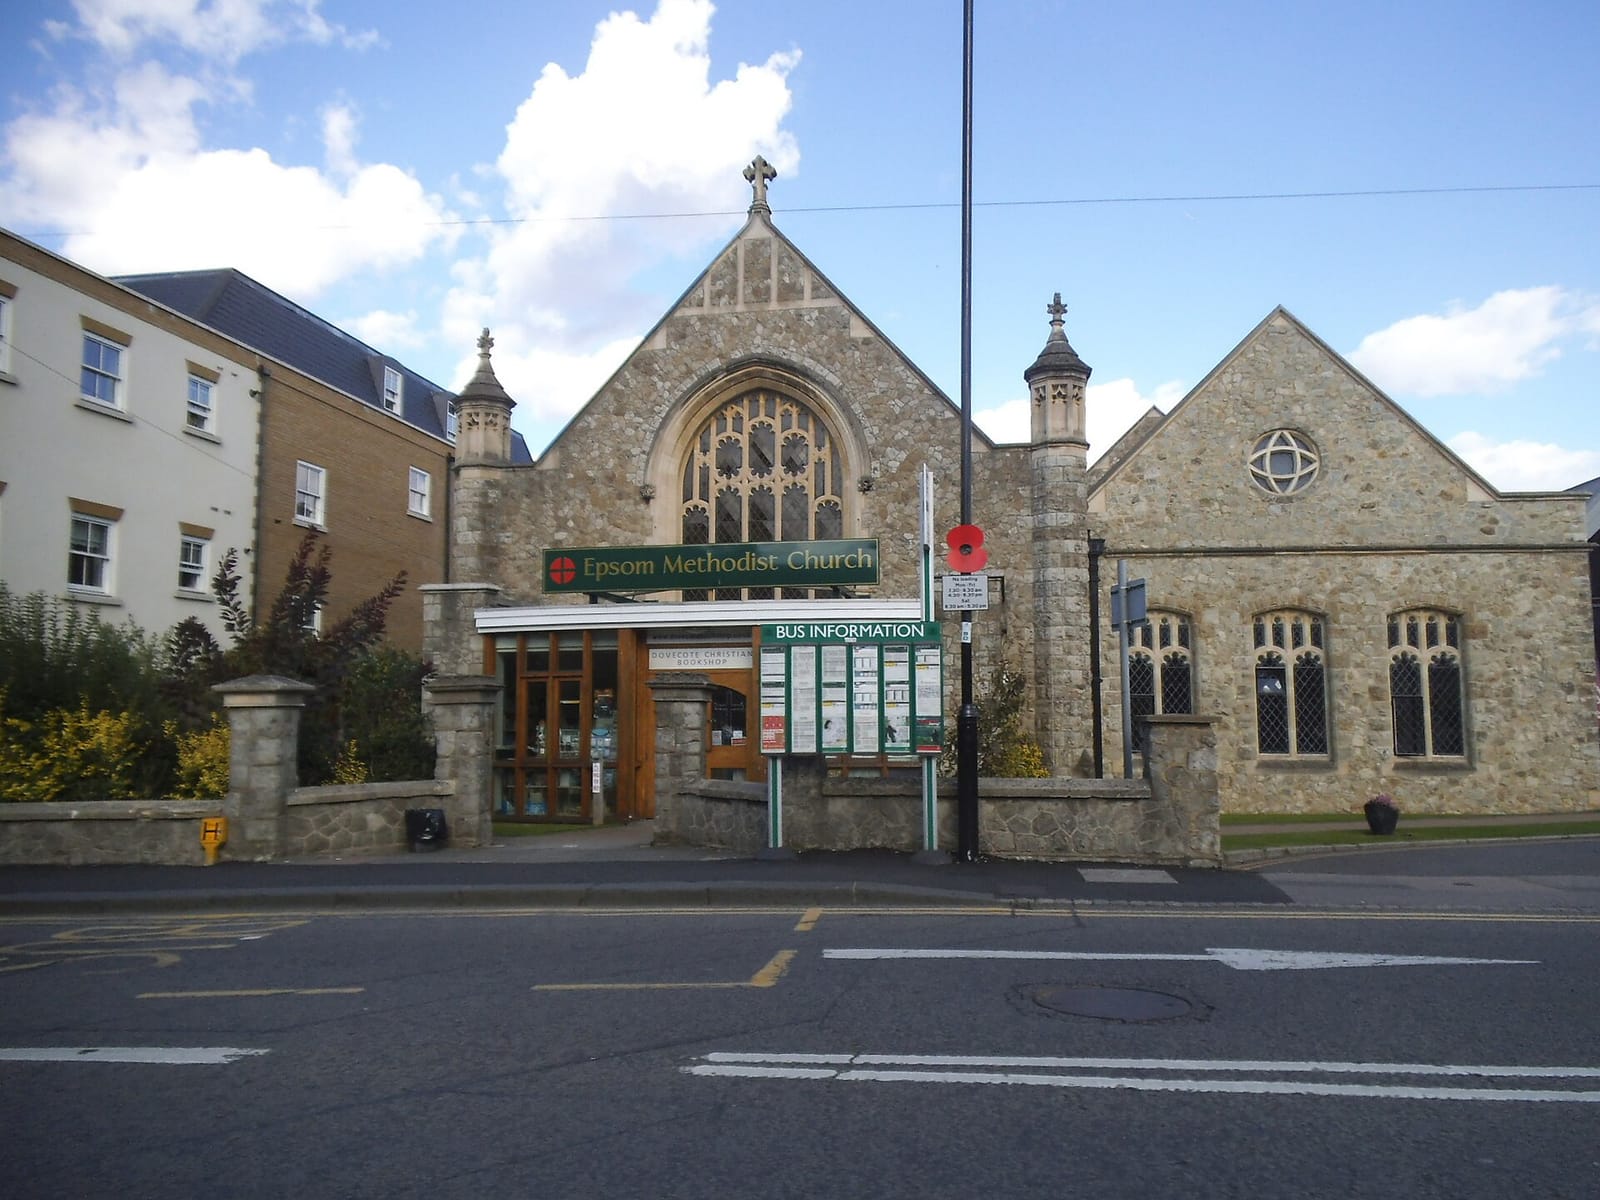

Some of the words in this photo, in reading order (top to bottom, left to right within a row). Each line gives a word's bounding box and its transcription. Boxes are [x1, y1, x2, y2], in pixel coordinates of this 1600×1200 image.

[583, 557, 655, 582] Epsom
[663, 551, 778, 574] Methodist
[787, 548, 873, 570] Church
[776, 625, 805, 639] BUS
[810, 624, 924, 638] INFORMATION
[651, 651, 699, 659] DOVECOTE
[704, 650, 752, 658] CHRISTIAN
[203, 821, 219, 841] H
